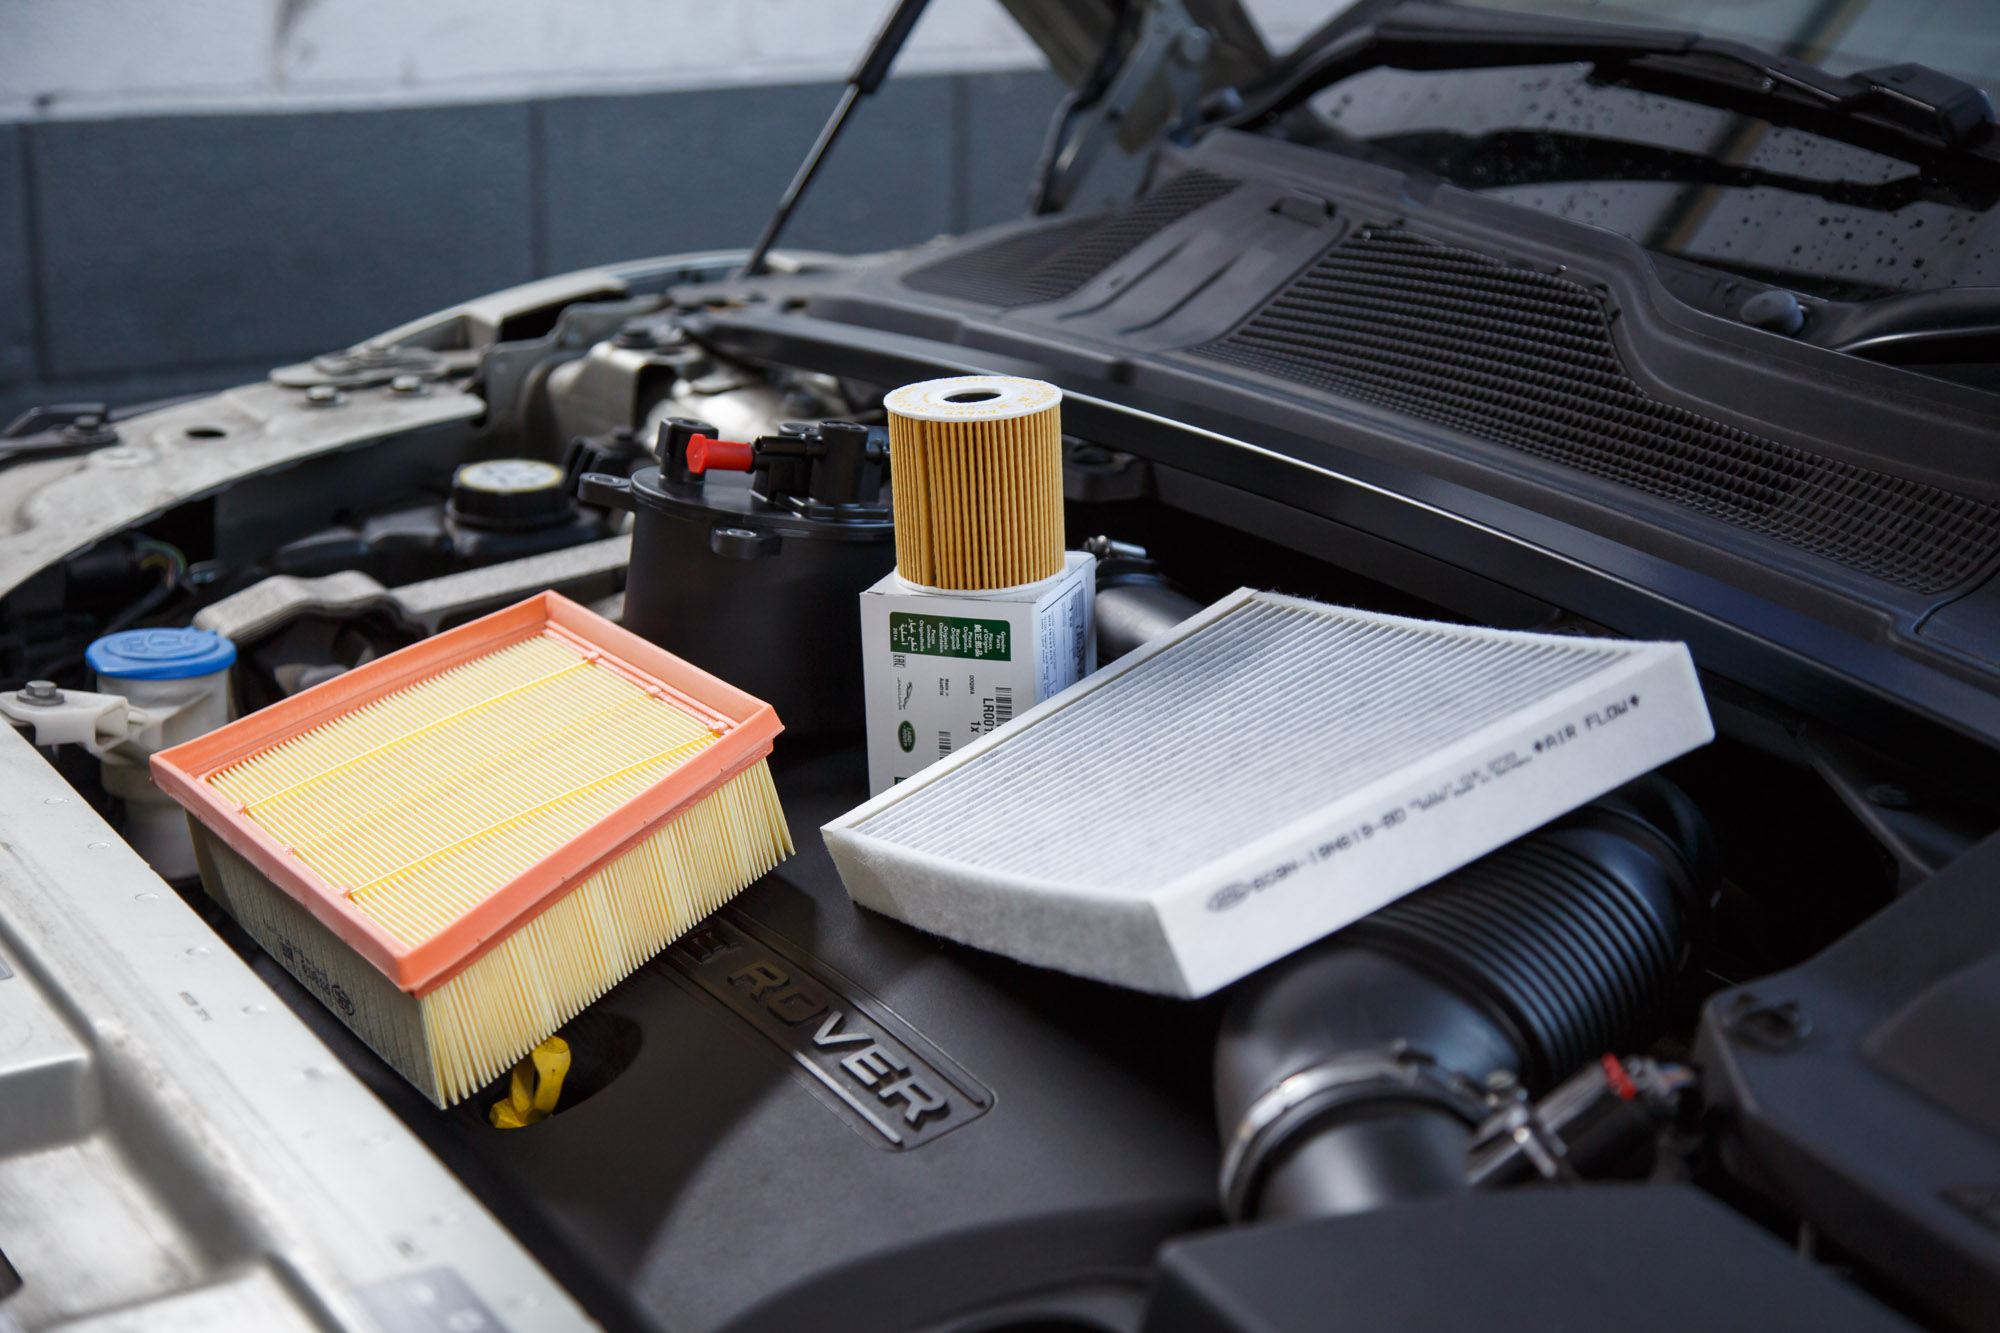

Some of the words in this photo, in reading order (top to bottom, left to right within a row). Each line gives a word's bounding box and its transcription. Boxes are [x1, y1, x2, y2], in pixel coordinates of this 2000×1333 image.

[970, 721, 981, 733] 1x
[983, 698, 995, 736] LR001
[1585, 699, 1630, 733] FLOW
[727, 961, 949, 1128] ROVER
